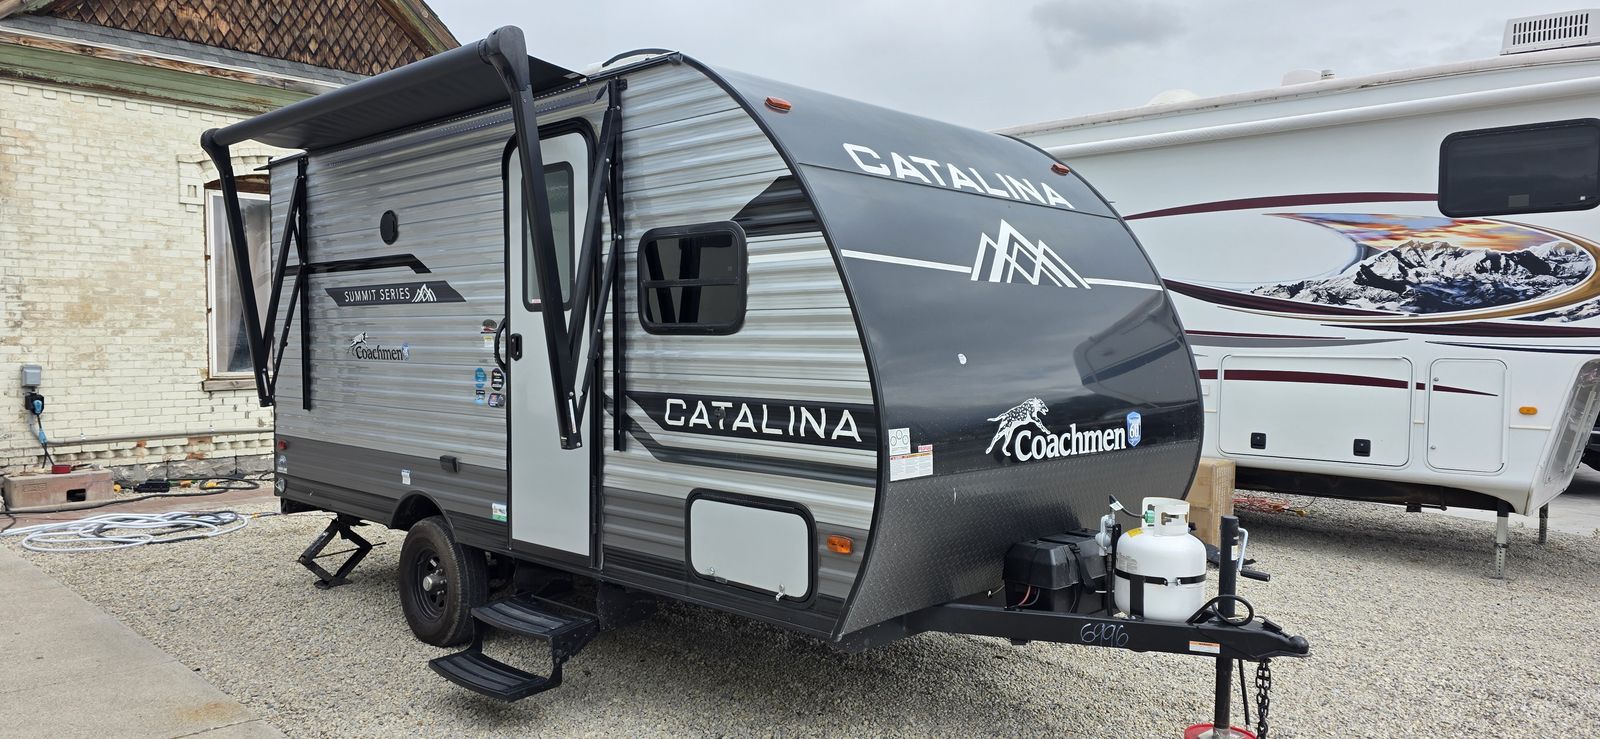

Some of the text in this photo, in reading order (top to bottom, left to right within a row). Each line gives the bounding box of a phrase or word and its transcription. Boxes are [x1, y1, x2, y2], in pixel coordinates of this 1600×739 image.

[842, 142, 1075, 210] CATALINA
[345, 288, 410, 302] SUMMIT SERIES
[356, 345, 403, 360] Coachmen
[664, 398, 862, 442] CATALINA
[1015, 423, 1126, 462] Coachmen
[1080, 622, 1129, 648] 6996
